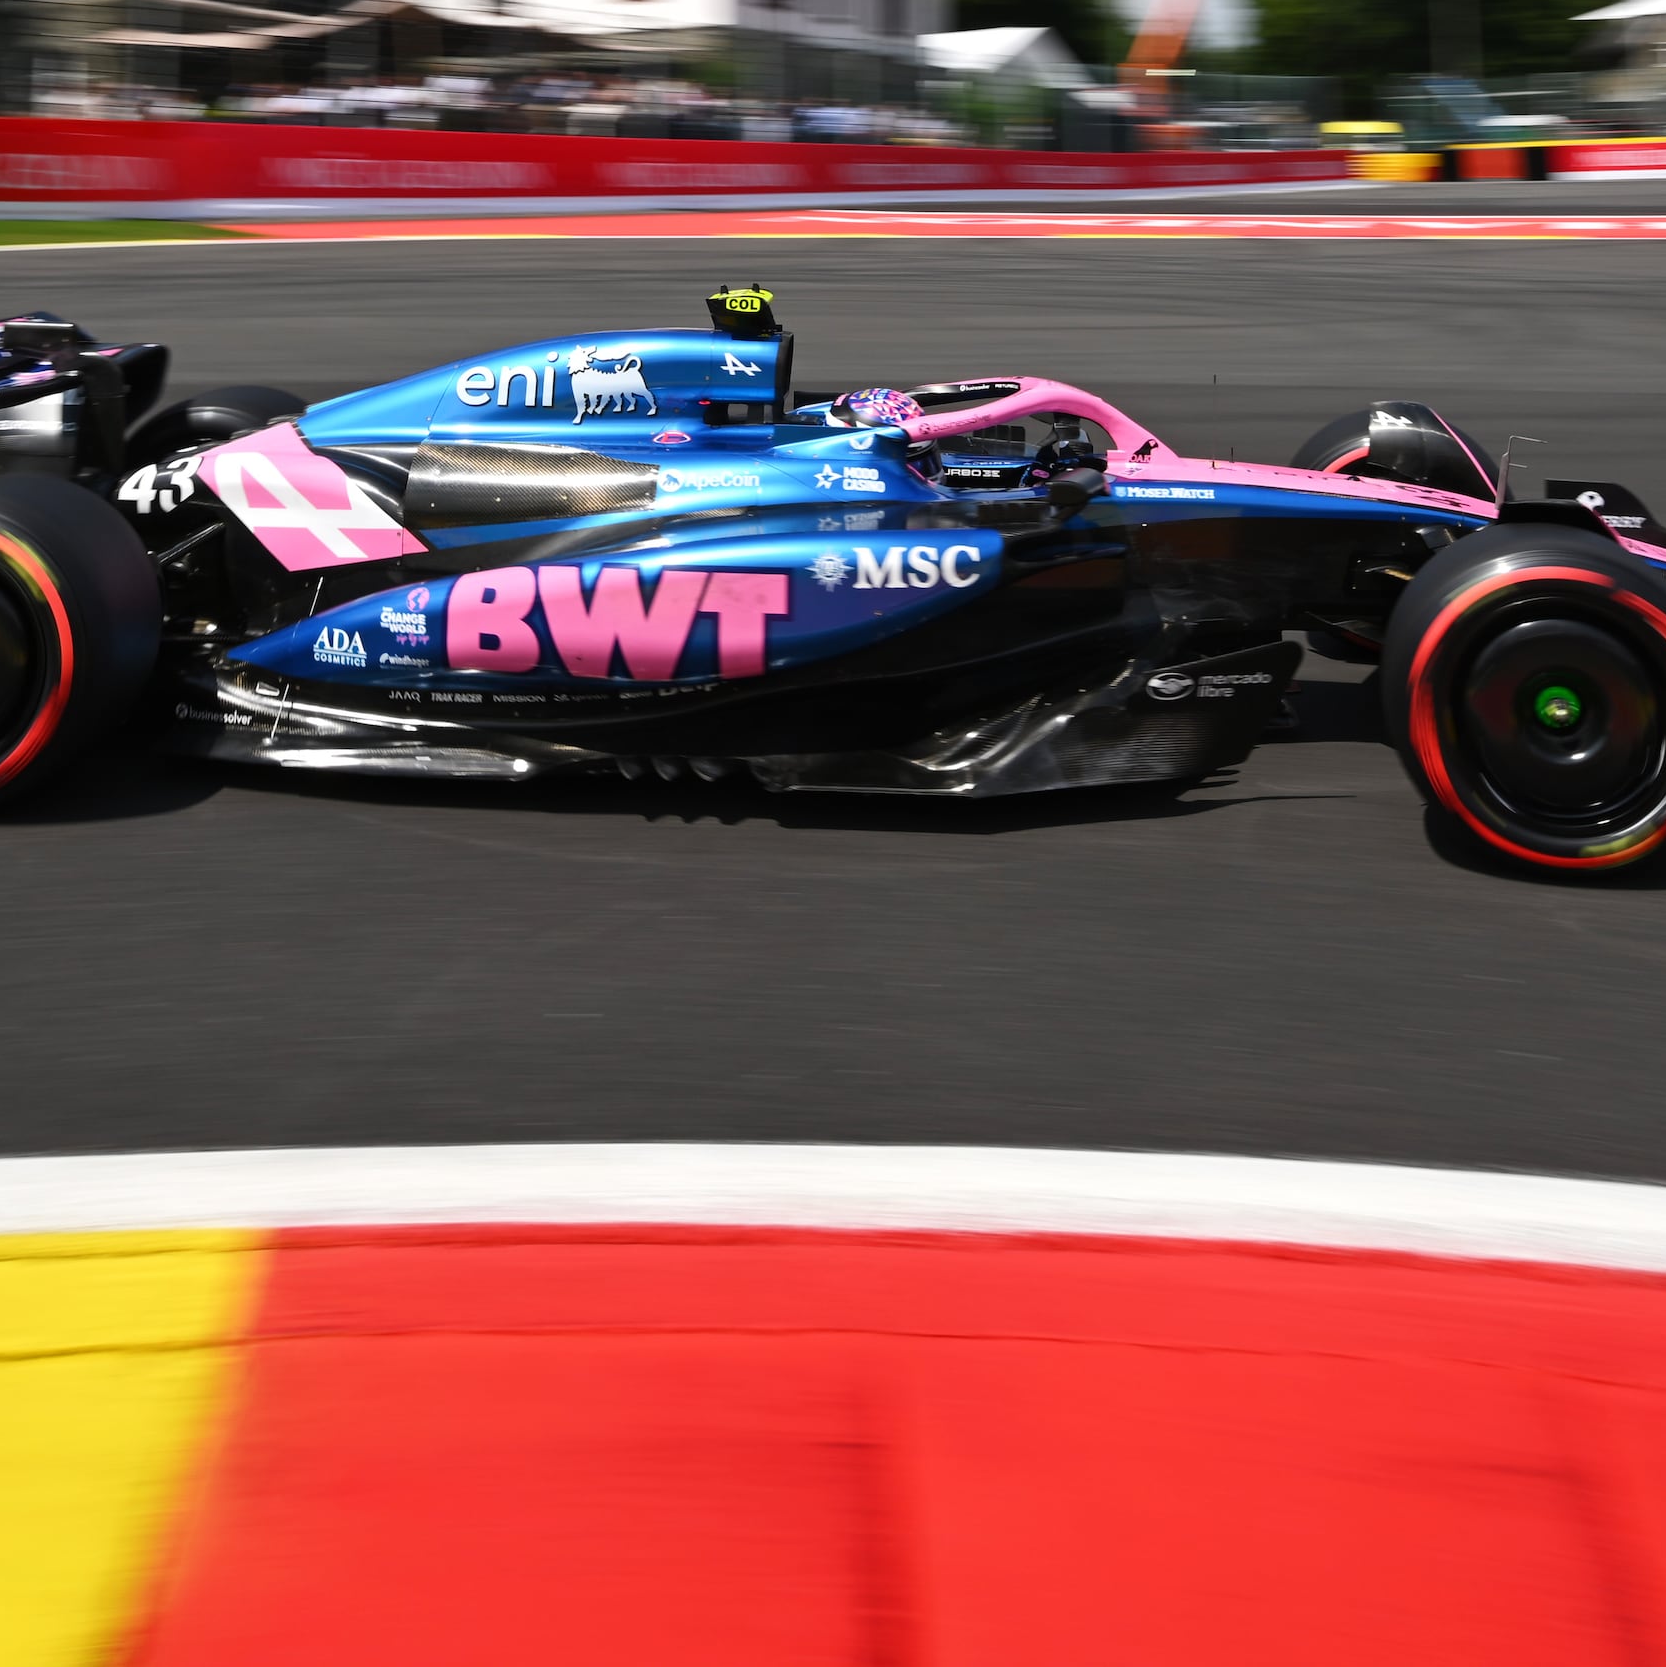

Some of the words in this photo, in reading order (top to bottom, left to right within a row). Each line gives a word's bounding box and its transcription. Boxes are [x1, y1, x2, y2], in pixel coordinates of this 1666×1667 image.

[729, 299, 757, 310] COL
[456, 351, 559, 407] eni
[944, 468, 981, 477] URBO
[117, 456, 203, 514] 43
[685, 471, 760, 491] ApeCoin
[852, 545, 981, 588] MSC
[380, 612, 426, 625] CHANGE
[447, 565, 789, 682] BWT
[390, 623, 427, 635] WORLD
[313, 626, 367, 655] ADA
[314, 652, 367, 667] COSMETICS
[1199, 672, 1273, 684] mercado
[493, 694, 546, 703] MISSION
[1197, 686, 1236, 697] libre
